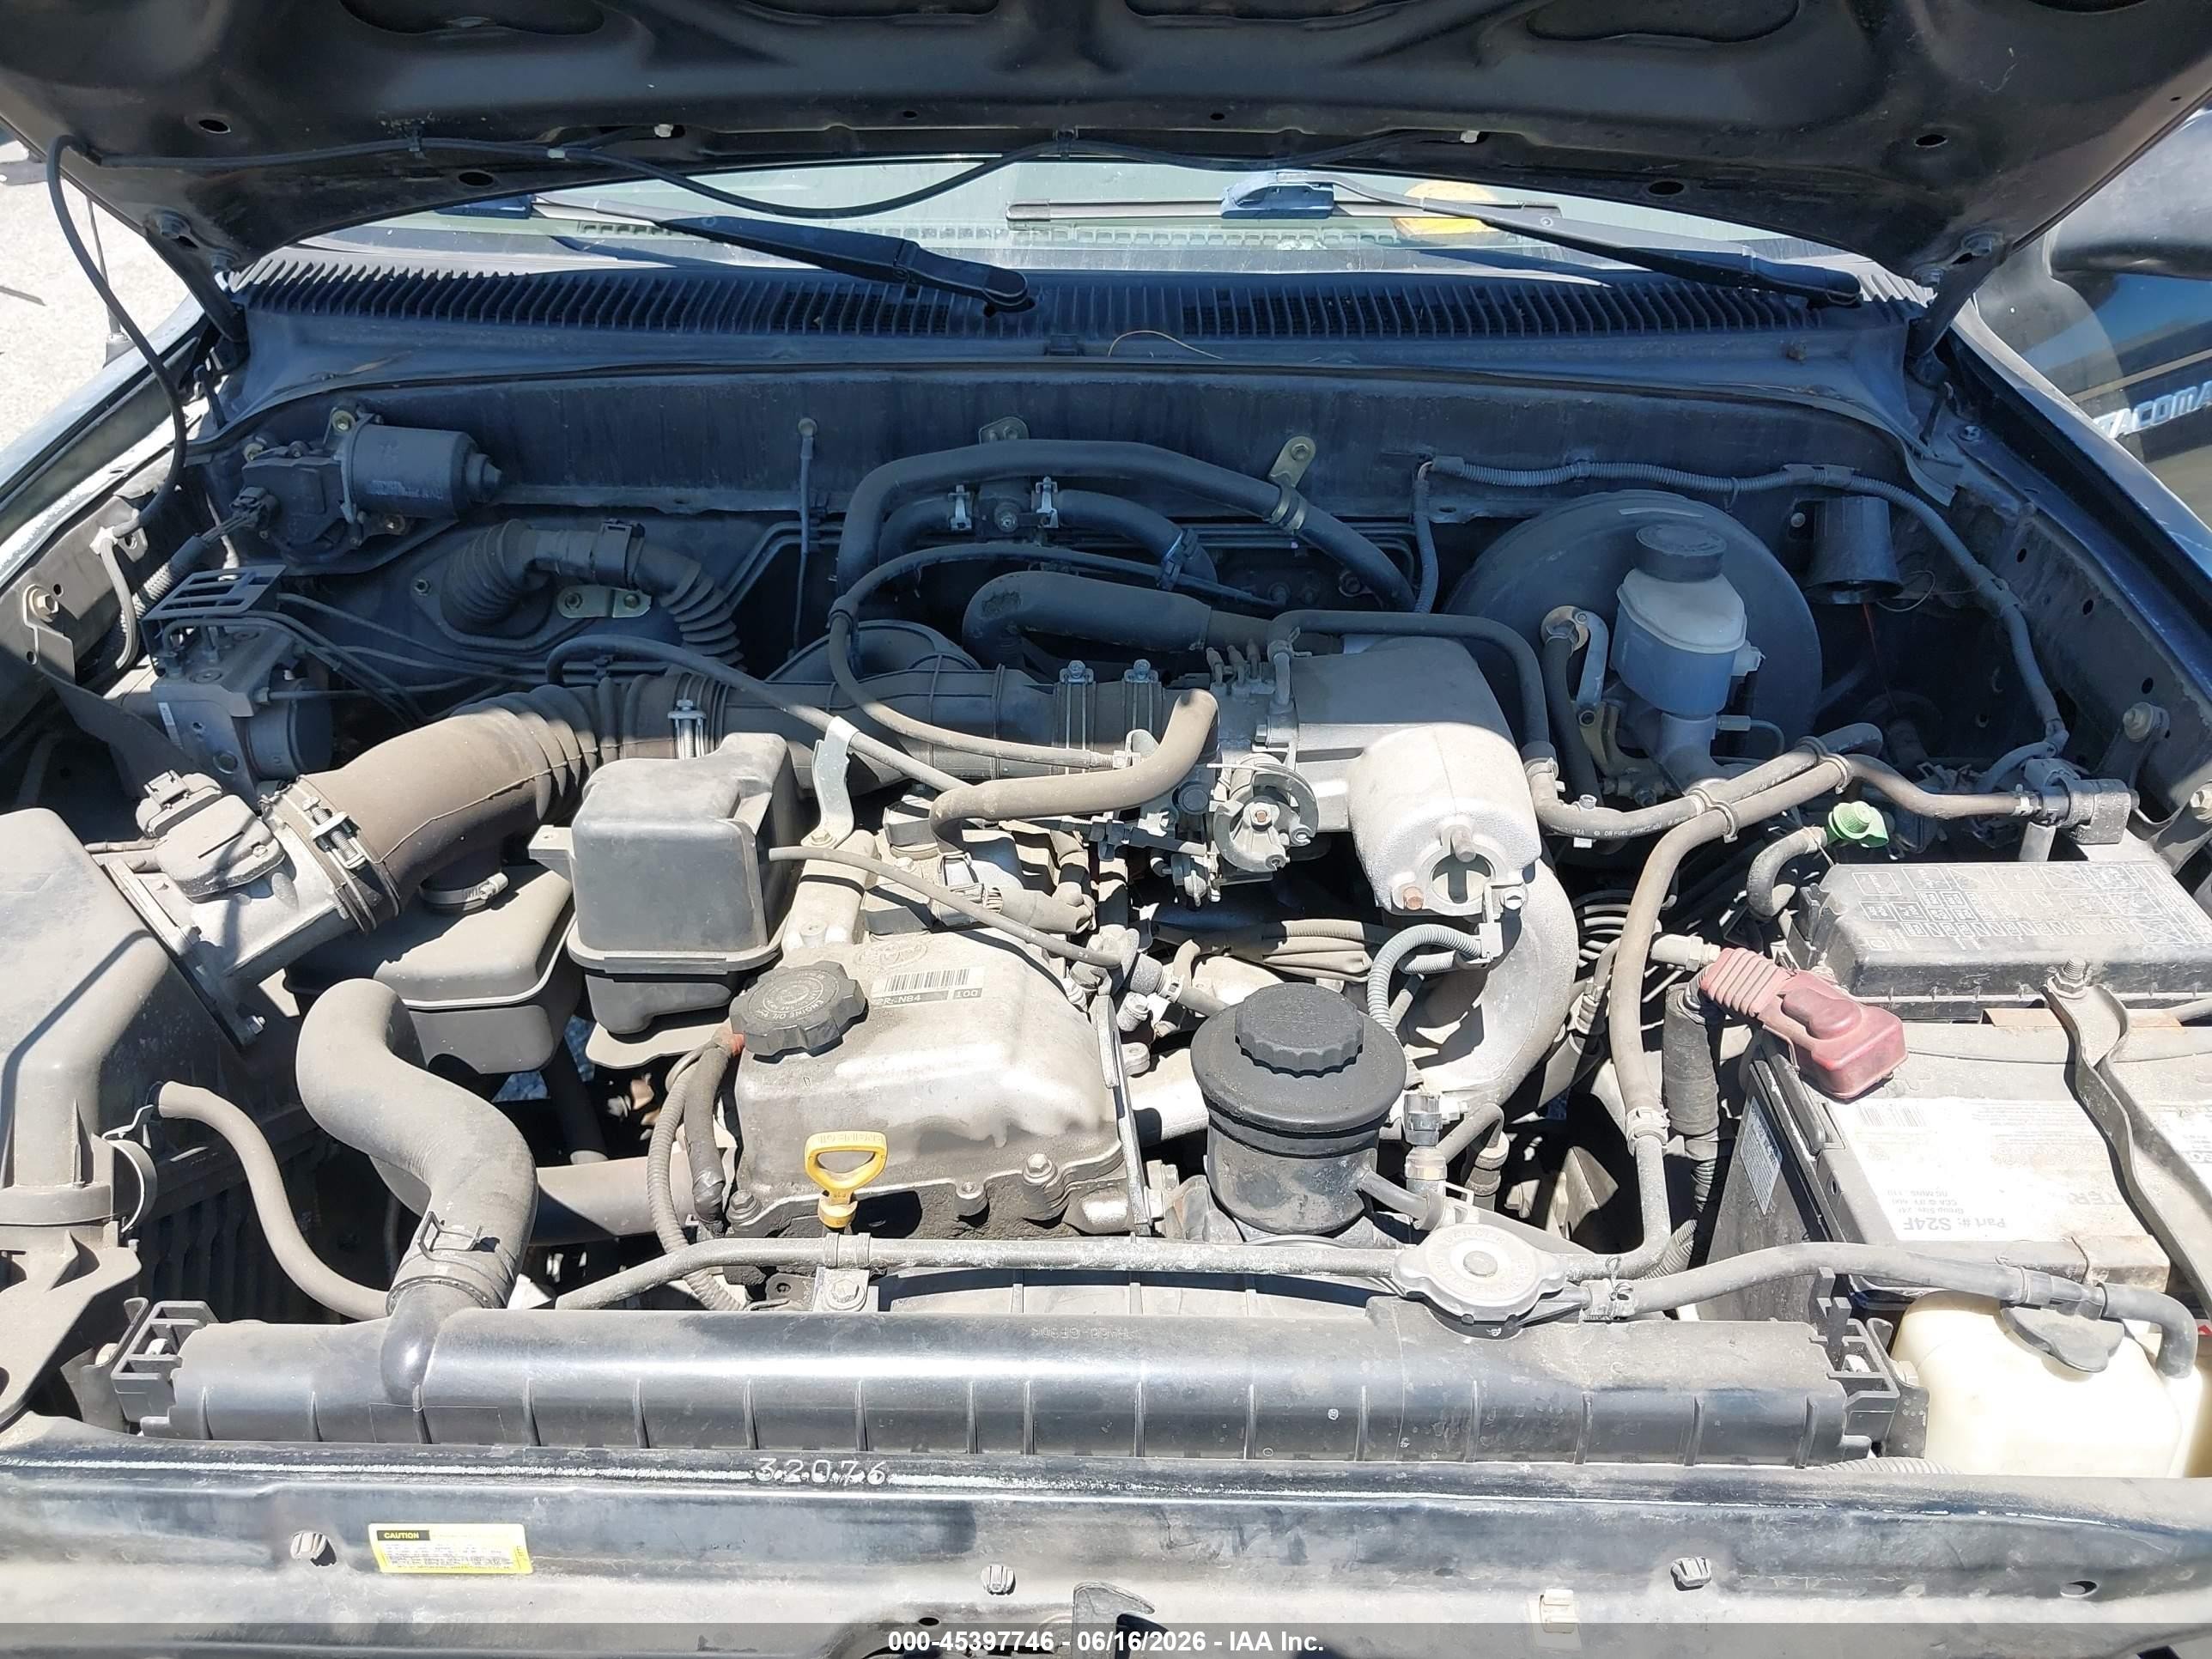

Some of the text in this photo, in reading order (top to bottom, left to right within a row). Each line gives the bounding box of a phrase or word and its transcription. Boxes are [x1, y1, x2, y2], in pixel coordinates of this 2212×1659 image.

[1903, 1217, 1952, 1231] S24F
[1976, 1218, 2006, 1228] Part
[756, 1457, 886, 1486] 32076
